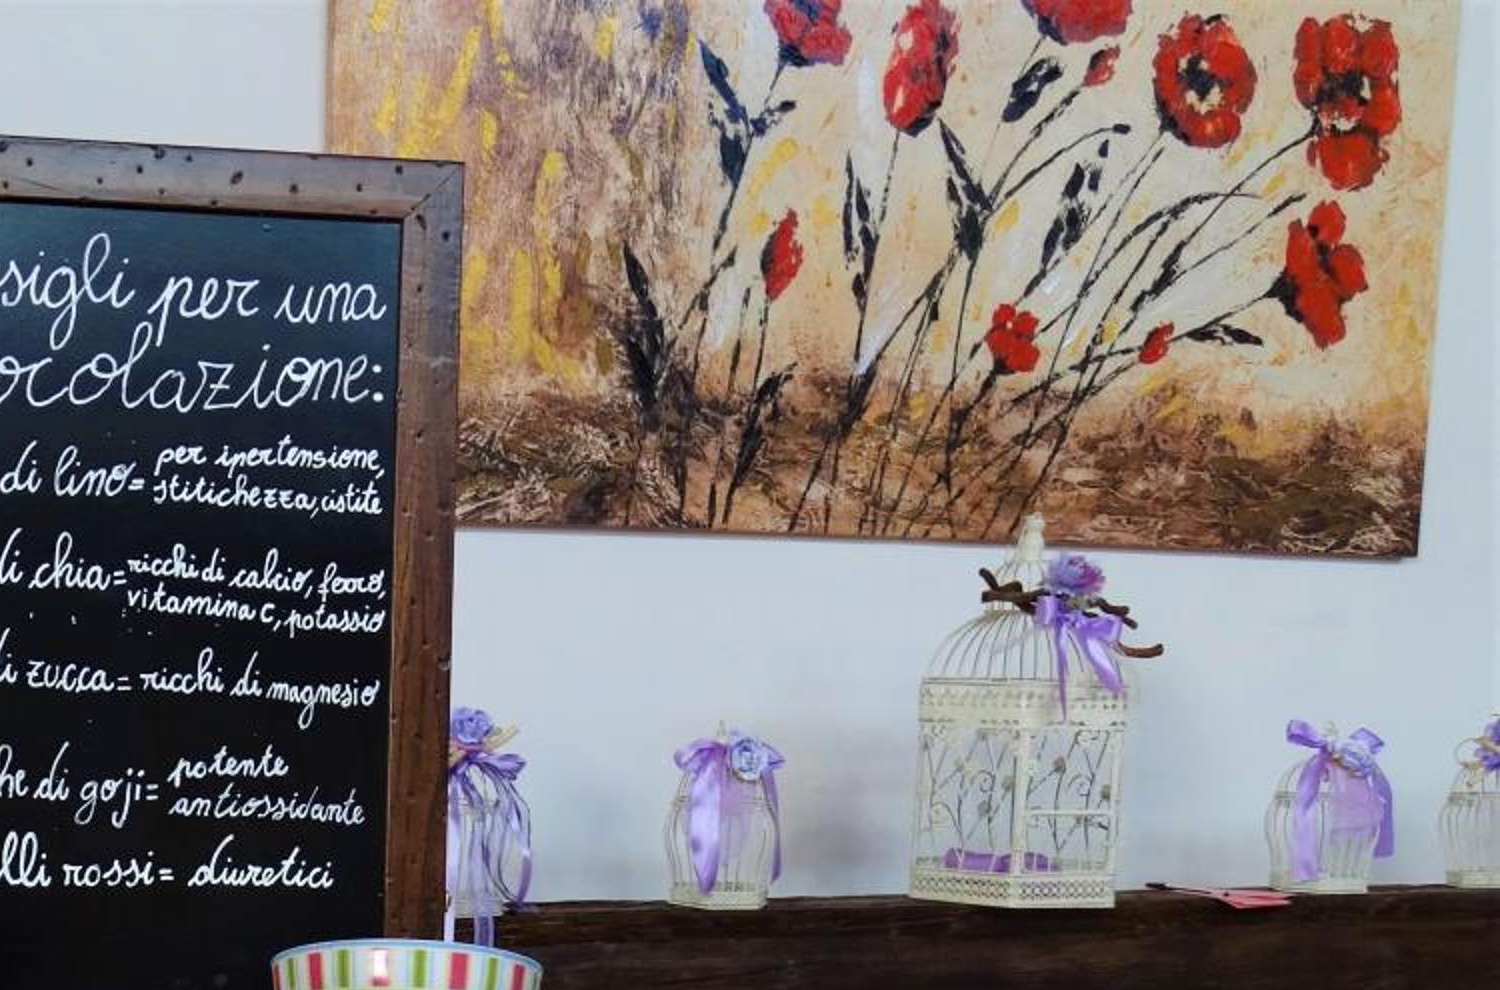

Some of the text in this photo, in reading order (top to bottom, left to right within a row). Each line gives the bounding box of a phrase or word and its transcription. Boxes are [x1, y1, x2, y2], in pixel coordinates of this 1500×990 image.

[145, 276, 260, 348] per
[273, 282, 387, 324] una
[0, 440, 43, 494] di
[153, 434, 385, 482] per ipertensione,
[127, 543, 200, 579] ricchi
[201, 548, 225, 583] di
[228, 547, 313, 599] calcio,
[127, 579, 258, 621] vitamina
[283, 603, 386, 639] potassio
[139, 647, 225, 695] ricchi
[229, 651, 263, 697] di
[265, 680, 380, 730] magnesio
[33, 741, 70, 801] di
[167, 744, 289, 788] potente
[168, 784, 365, 825] antiossidante
[187, 834, 334, 889] diuretici
